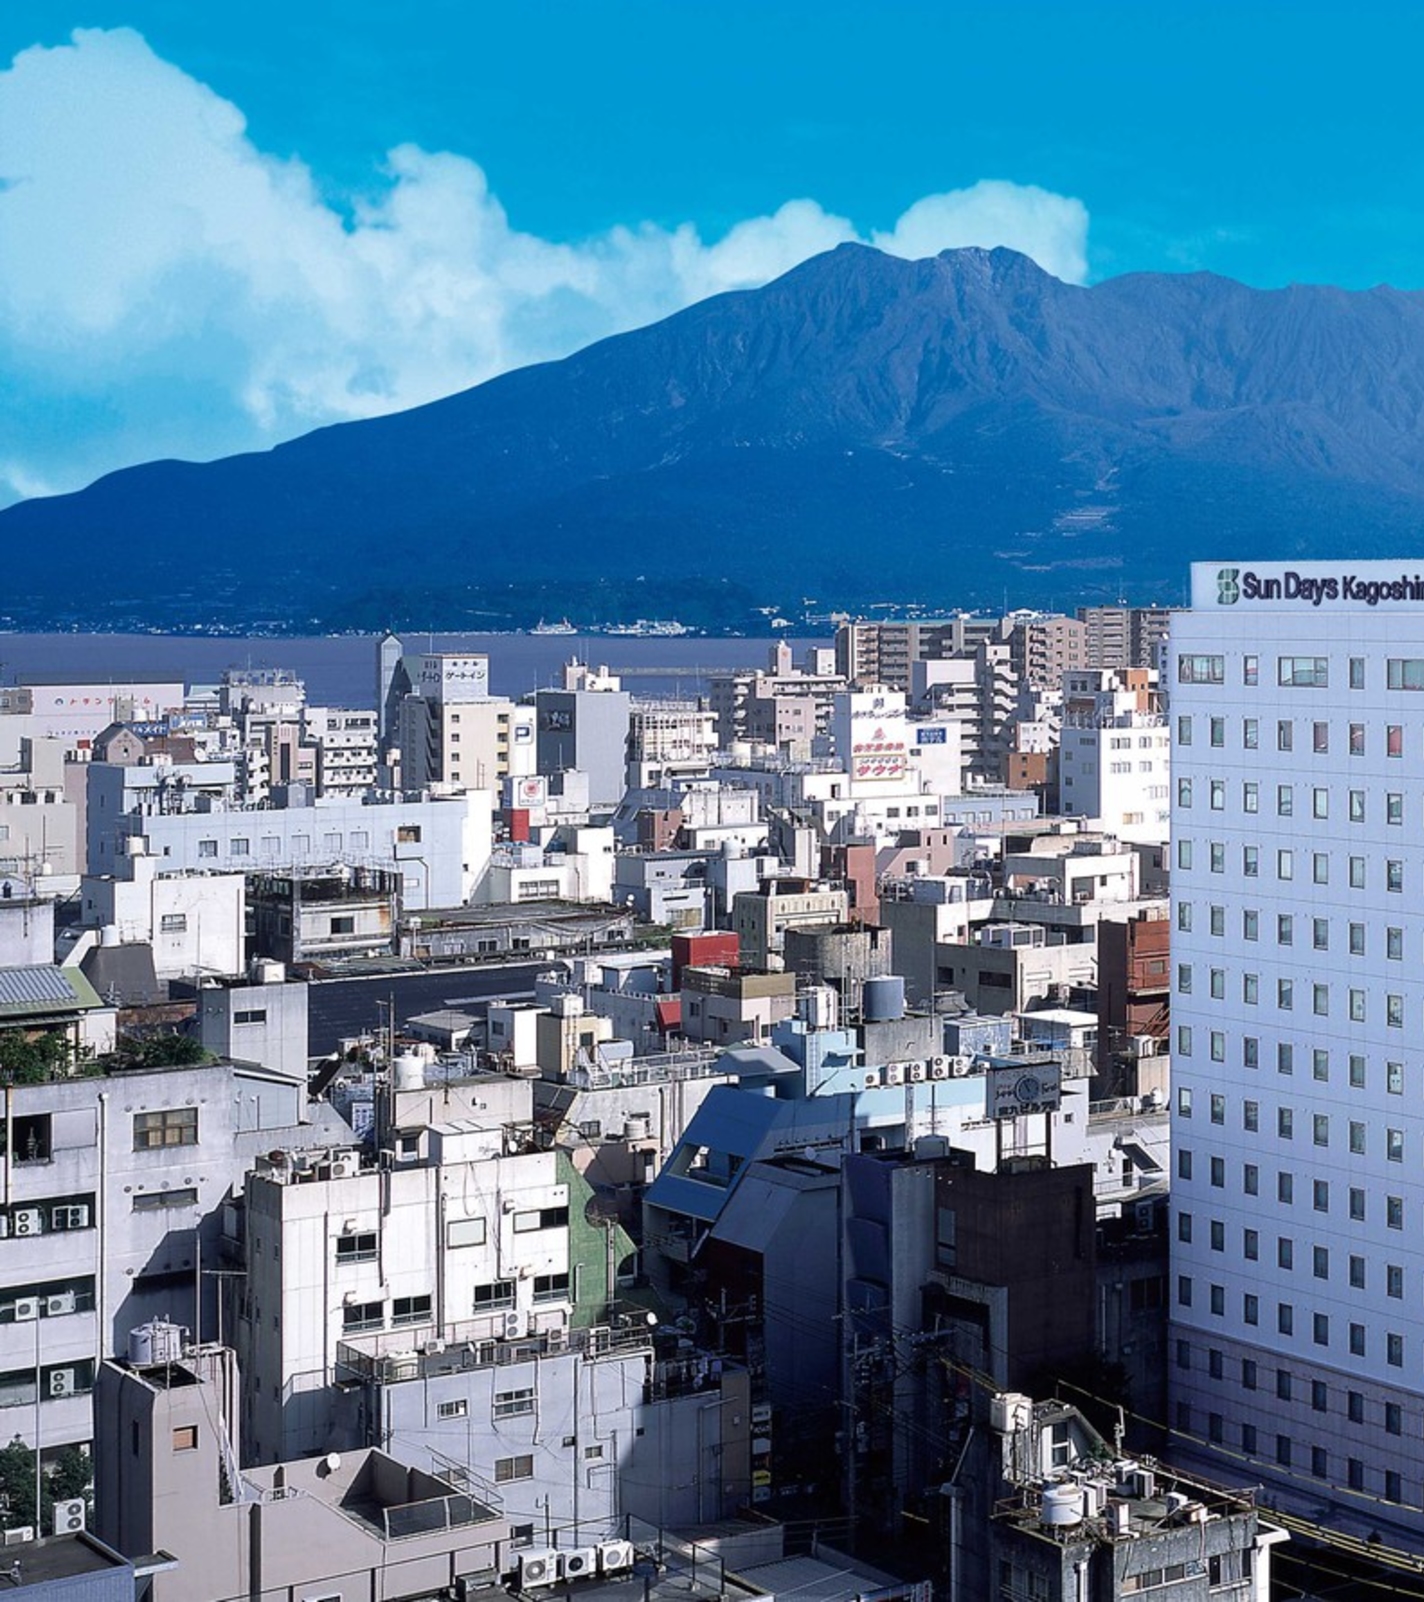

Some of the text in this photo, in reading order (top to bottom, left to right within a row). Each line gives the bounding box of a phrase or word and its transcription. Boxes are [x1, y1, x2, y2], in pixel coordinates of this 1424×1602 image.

[1242, 571, 1281, 600] Sun
[1284, 571, 1338, 606] Days
[69, 697, 150, 705] トランクーム
[515, 726, 530, 742] P
[857, 764, 903, 777] サウナ
